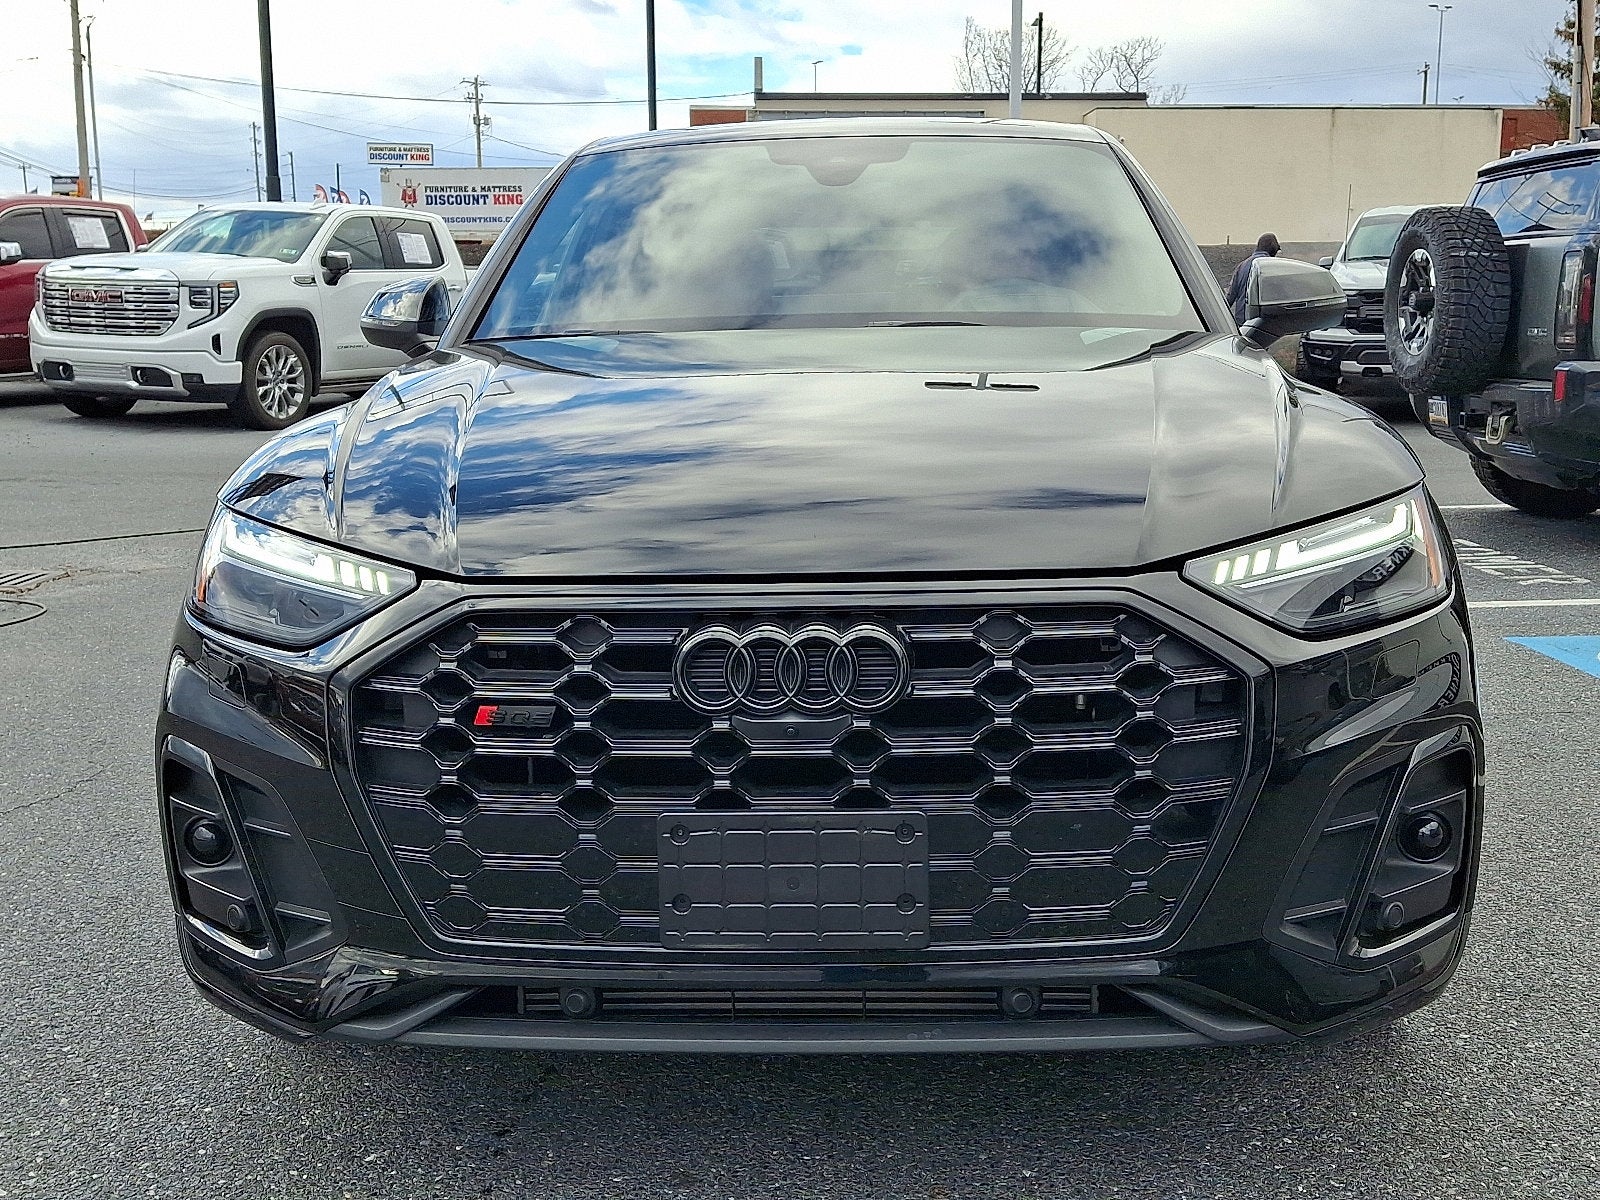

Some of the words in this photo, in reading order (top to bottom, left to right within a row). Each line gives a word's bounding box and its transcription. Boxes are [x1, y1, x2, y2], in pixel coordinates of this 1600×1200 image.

[369, 153, 409, 161] DISCOUNT
[410, 153, 430, 161] KING
[425, 194, 489, 206] DISCOUNT
[493, 194, 523, 205] KING
[71, 289, 121, 302] GMC
[486, 708, 553, 727] SQ5
